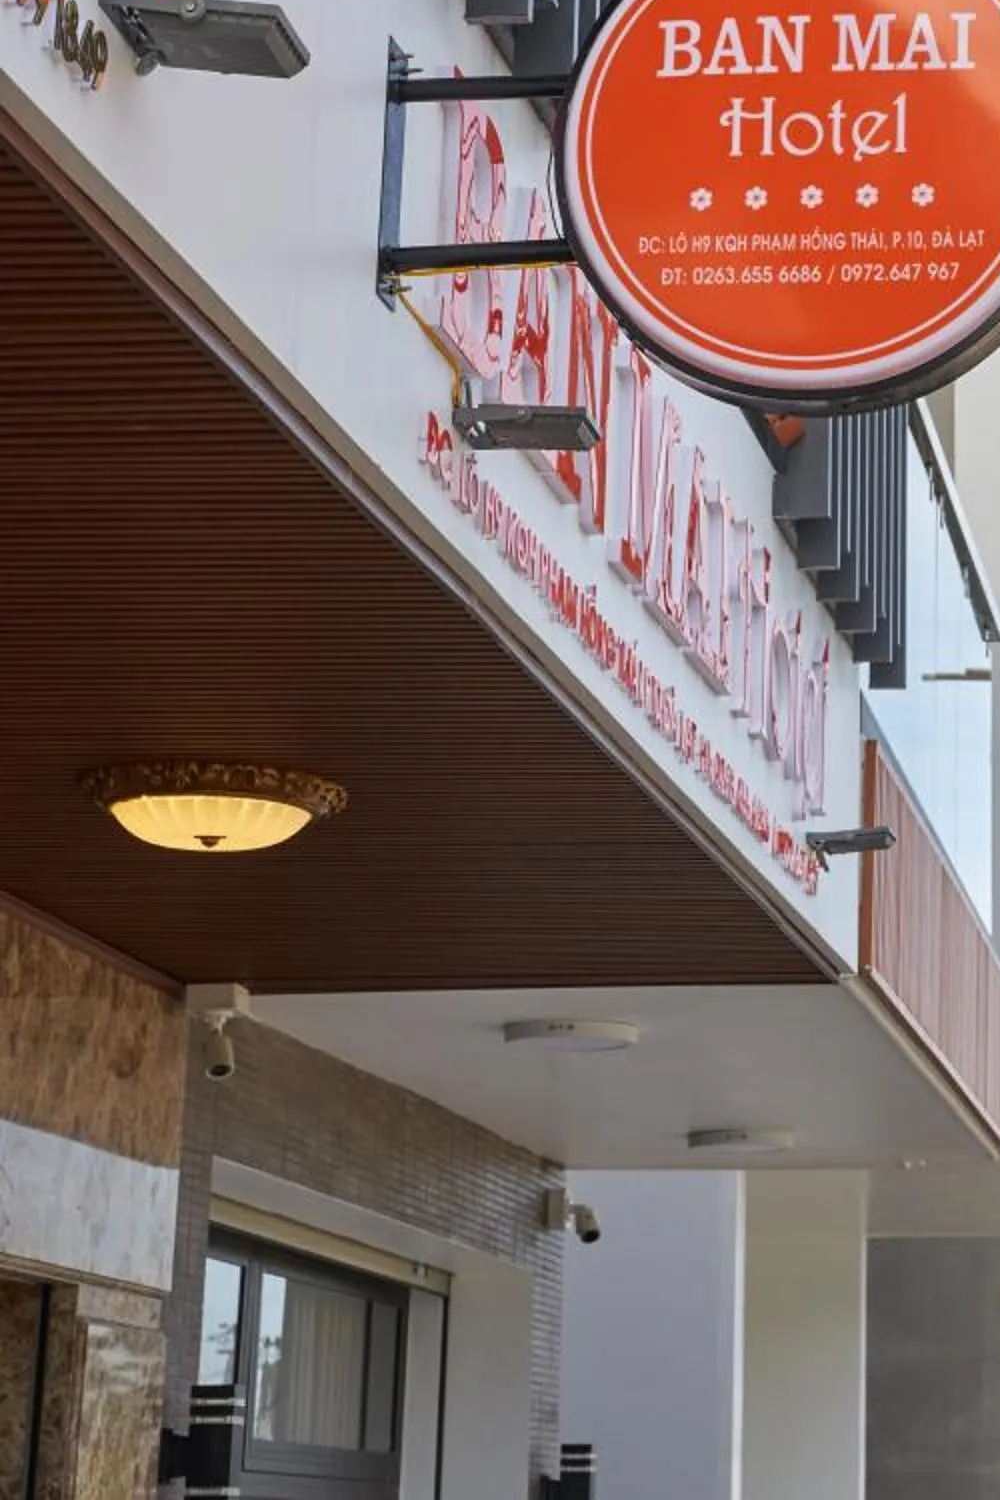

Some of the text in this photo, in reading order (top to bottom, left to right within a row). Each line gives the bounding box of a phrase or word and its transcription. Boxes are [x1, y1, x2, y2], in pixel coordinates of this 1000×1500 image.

[656, 12, 977, 77] BAN MAI
[719, 92, 907, 161] Hotel
[669, 231, 688, 253] LÔ
[691, 235, 711, 253] H9
[715, 235, 747, 252] KQH
[661, 268, 687, 285] ĐT:
[692, 266, 773, 285] 0263.655
[778, 264, 822, 284] 6686
[840, 263, 922, 283] 0972.647
[927, 261, 960, 281] 967
